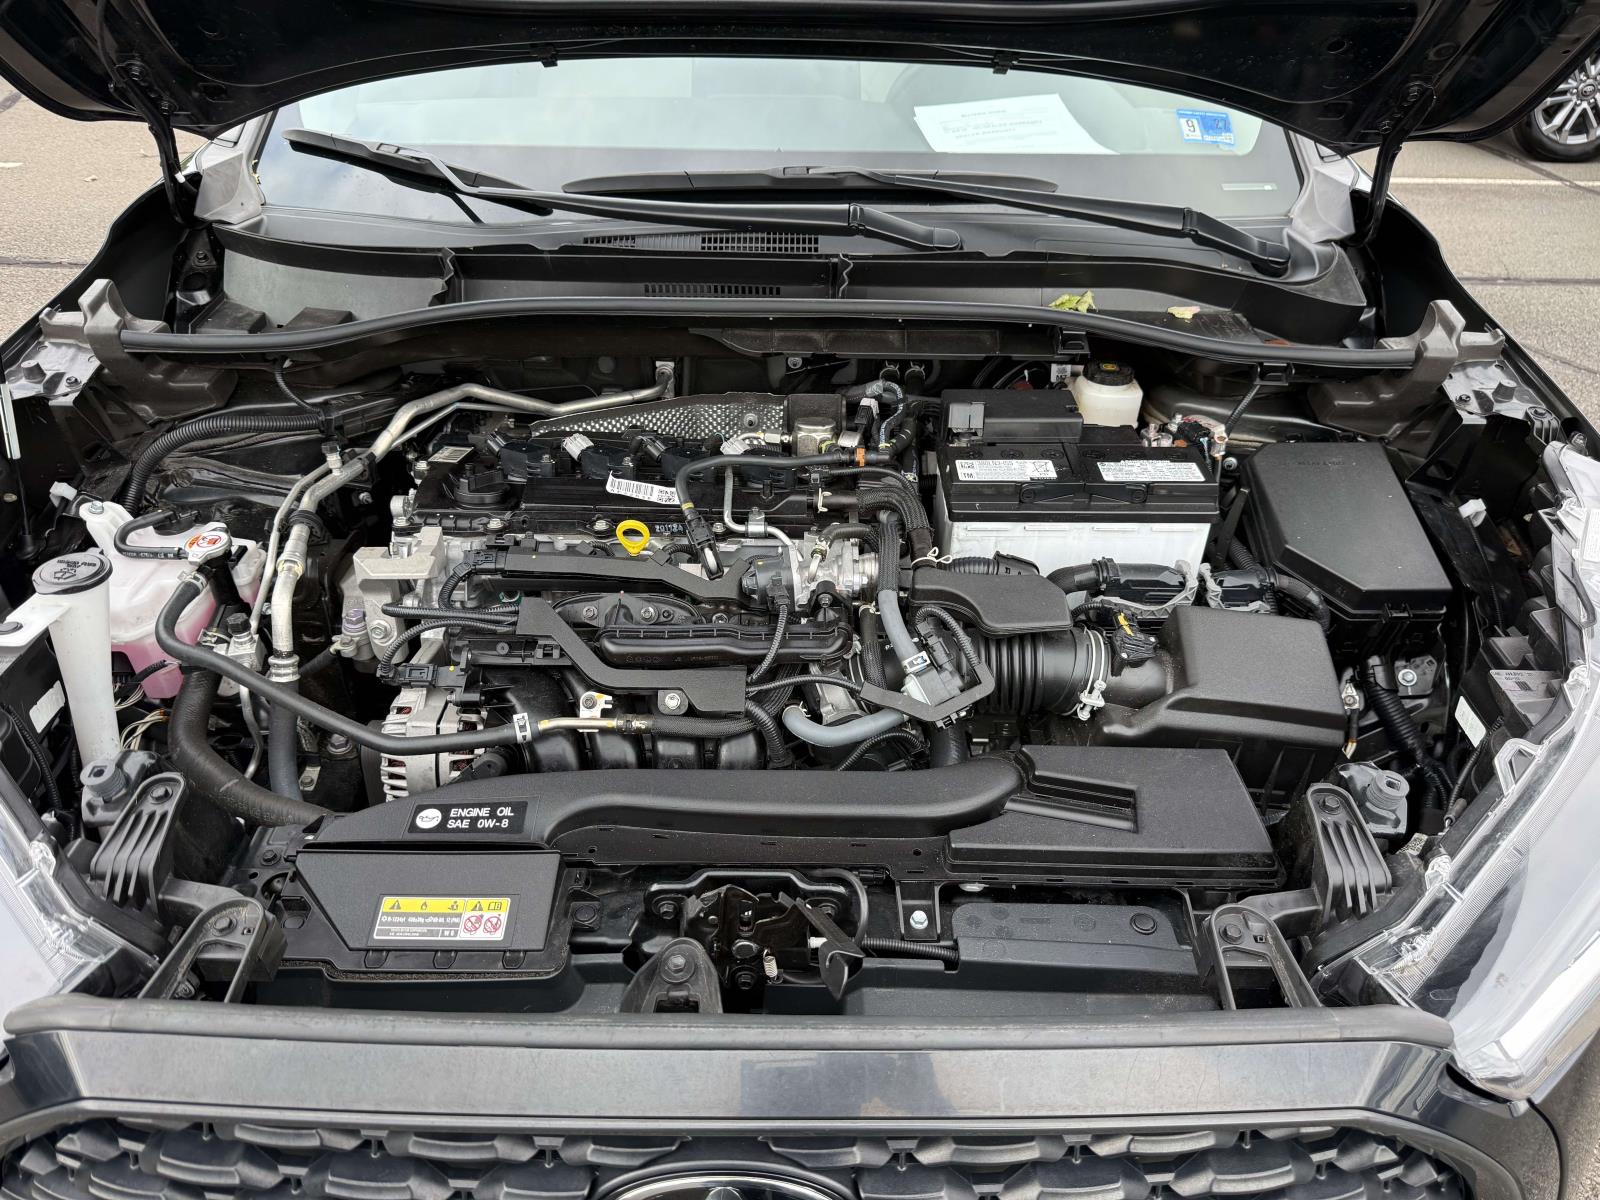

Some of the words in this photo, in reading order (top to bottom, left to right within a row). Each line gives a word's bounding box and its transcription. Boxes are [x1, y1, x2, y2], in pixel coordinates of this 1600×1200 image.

[1185, 119, 1196, 133] 9
[450, 807, 490, 818] ENGINE
[497, 806, 515, 816] OIL
[446, 819, 471, 829] SAE
[477, 818, 509, 829] 0W-8
